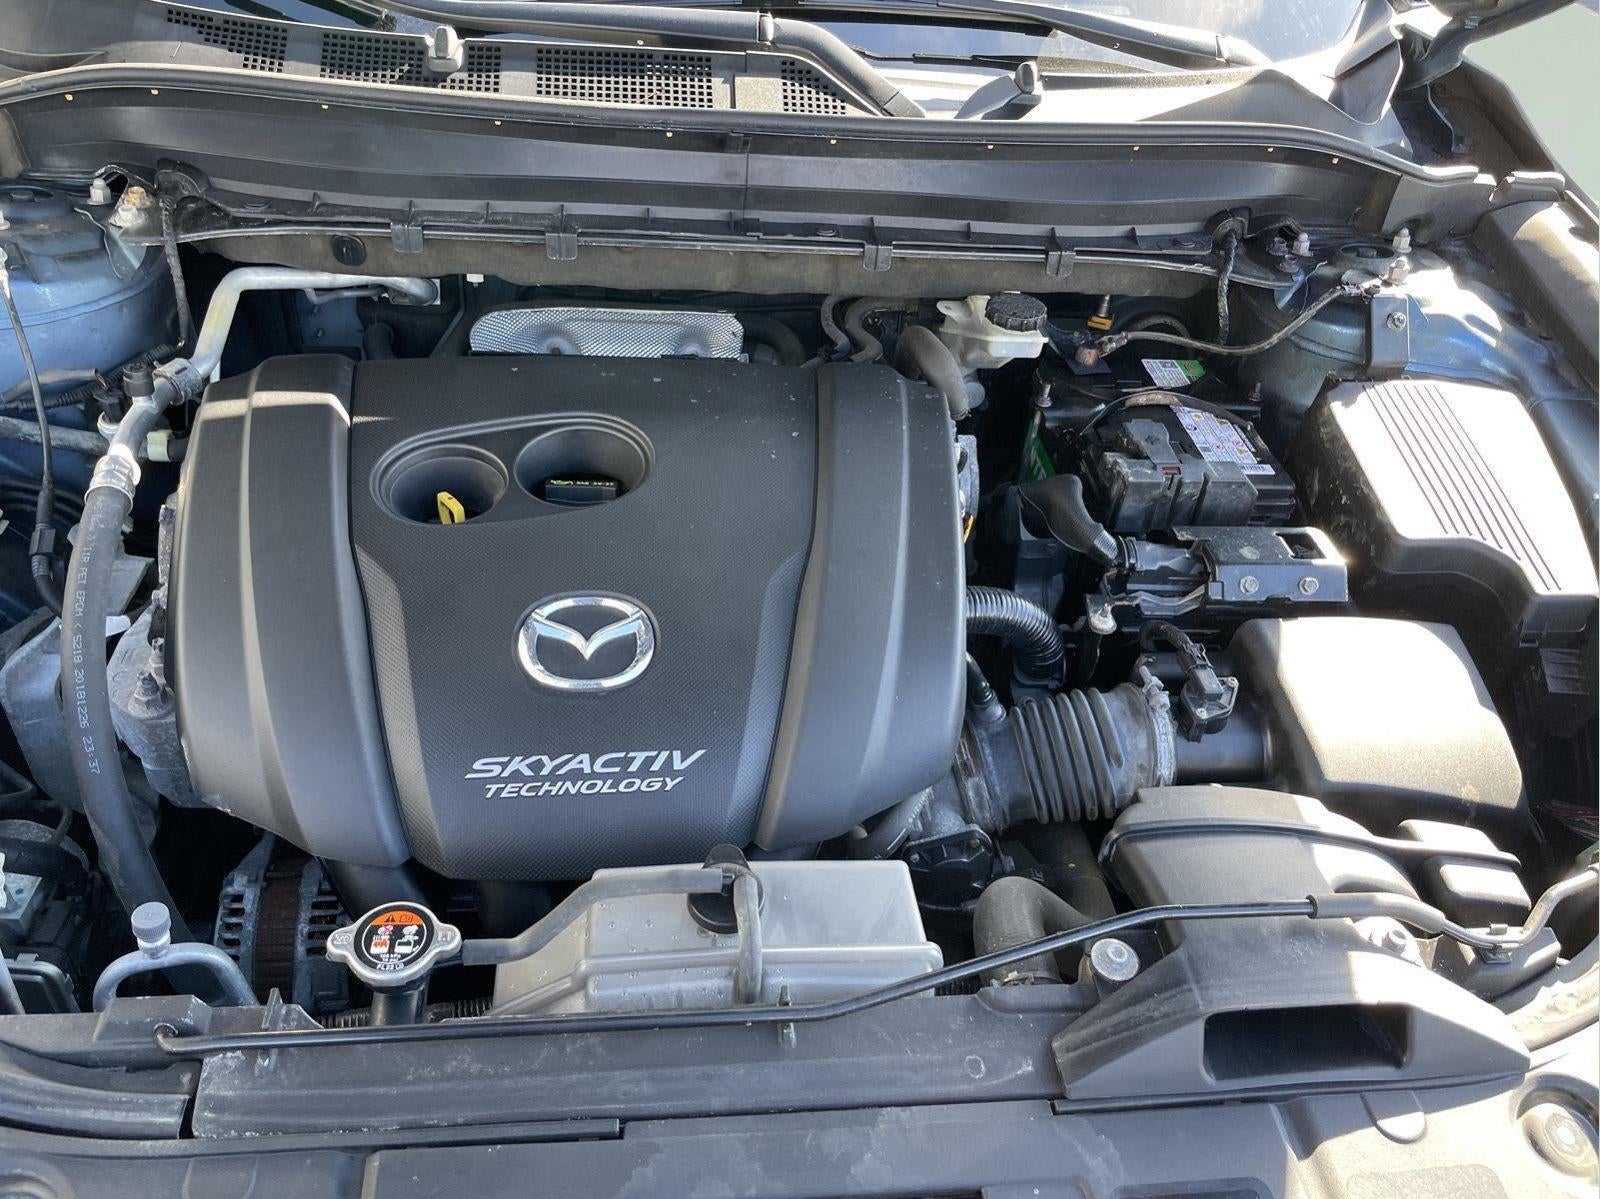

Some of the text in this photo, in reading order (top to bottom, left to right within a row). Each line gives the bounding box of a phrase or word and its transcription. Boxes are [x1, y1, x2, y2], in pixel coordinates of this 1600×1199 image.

[465, 749, 707, 779] SKYACTIV
[485, 776, 685, 799] TECHNOLOGY
[376, 963, 394, 971] FL22
